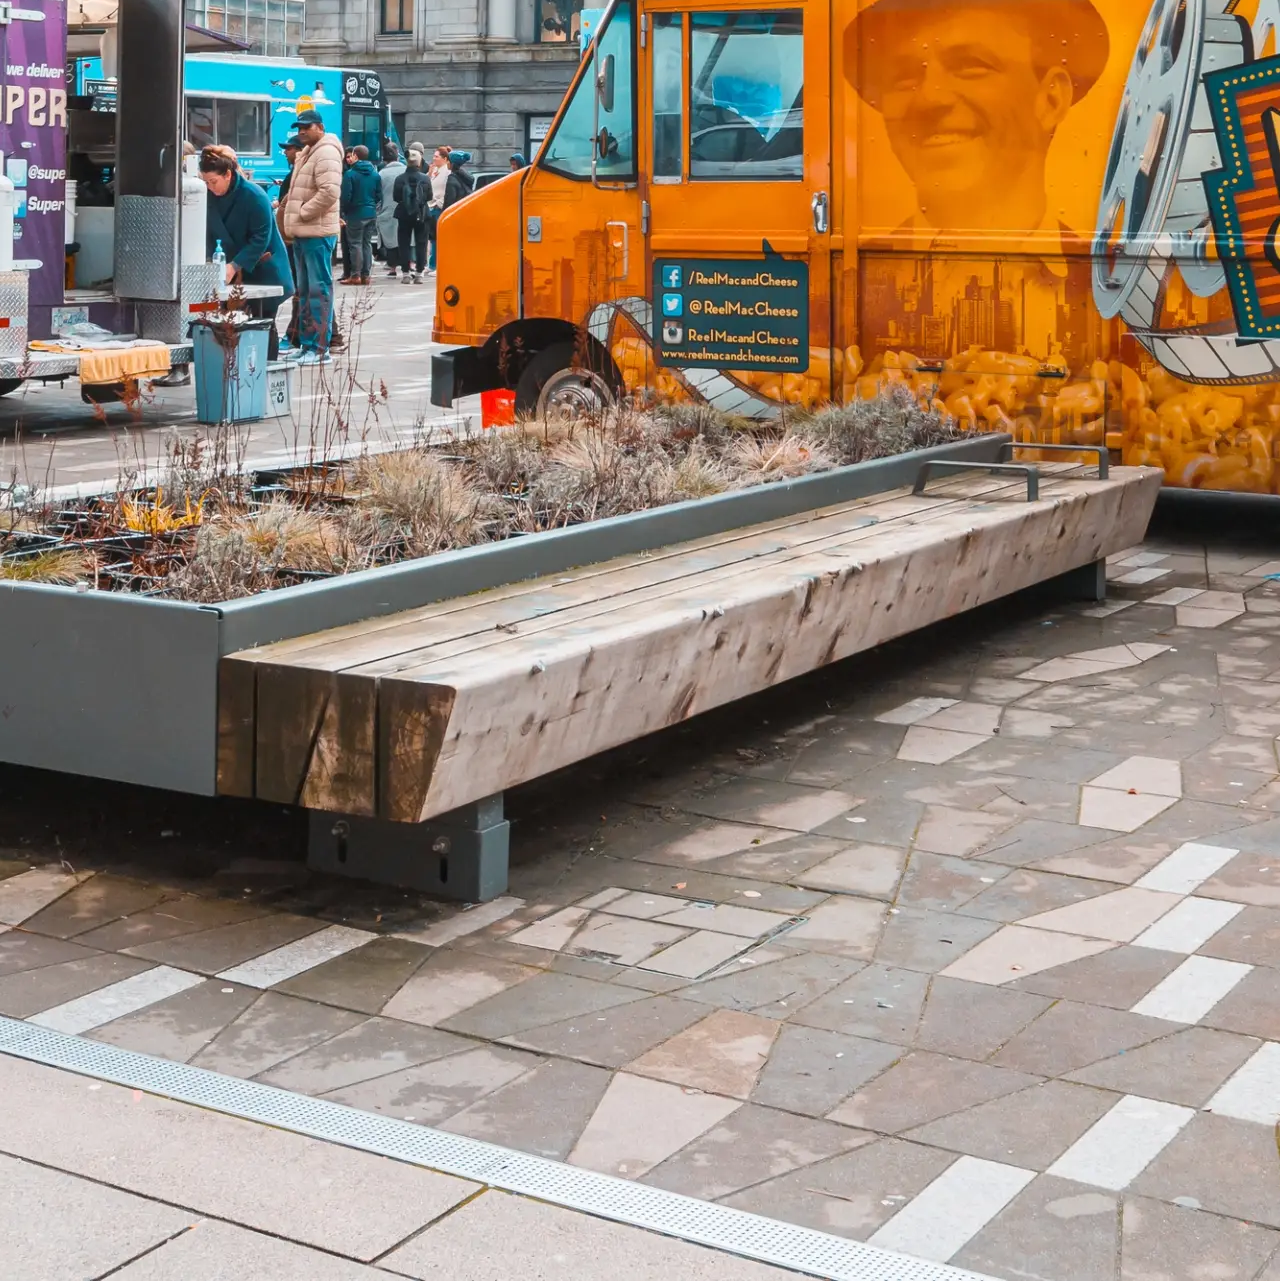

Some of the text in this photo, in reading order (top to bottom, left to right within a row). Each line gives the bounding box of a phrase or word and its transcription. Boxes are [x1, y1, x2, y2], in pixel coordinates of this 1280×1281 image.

[6, 62, 64, 79] we deliver
[27, 196, 65, 215] Super
[688, 271, 798, 287] /ReelMacandCheese
[662, 347, 799, 364] www.reelmacandcheese.com
